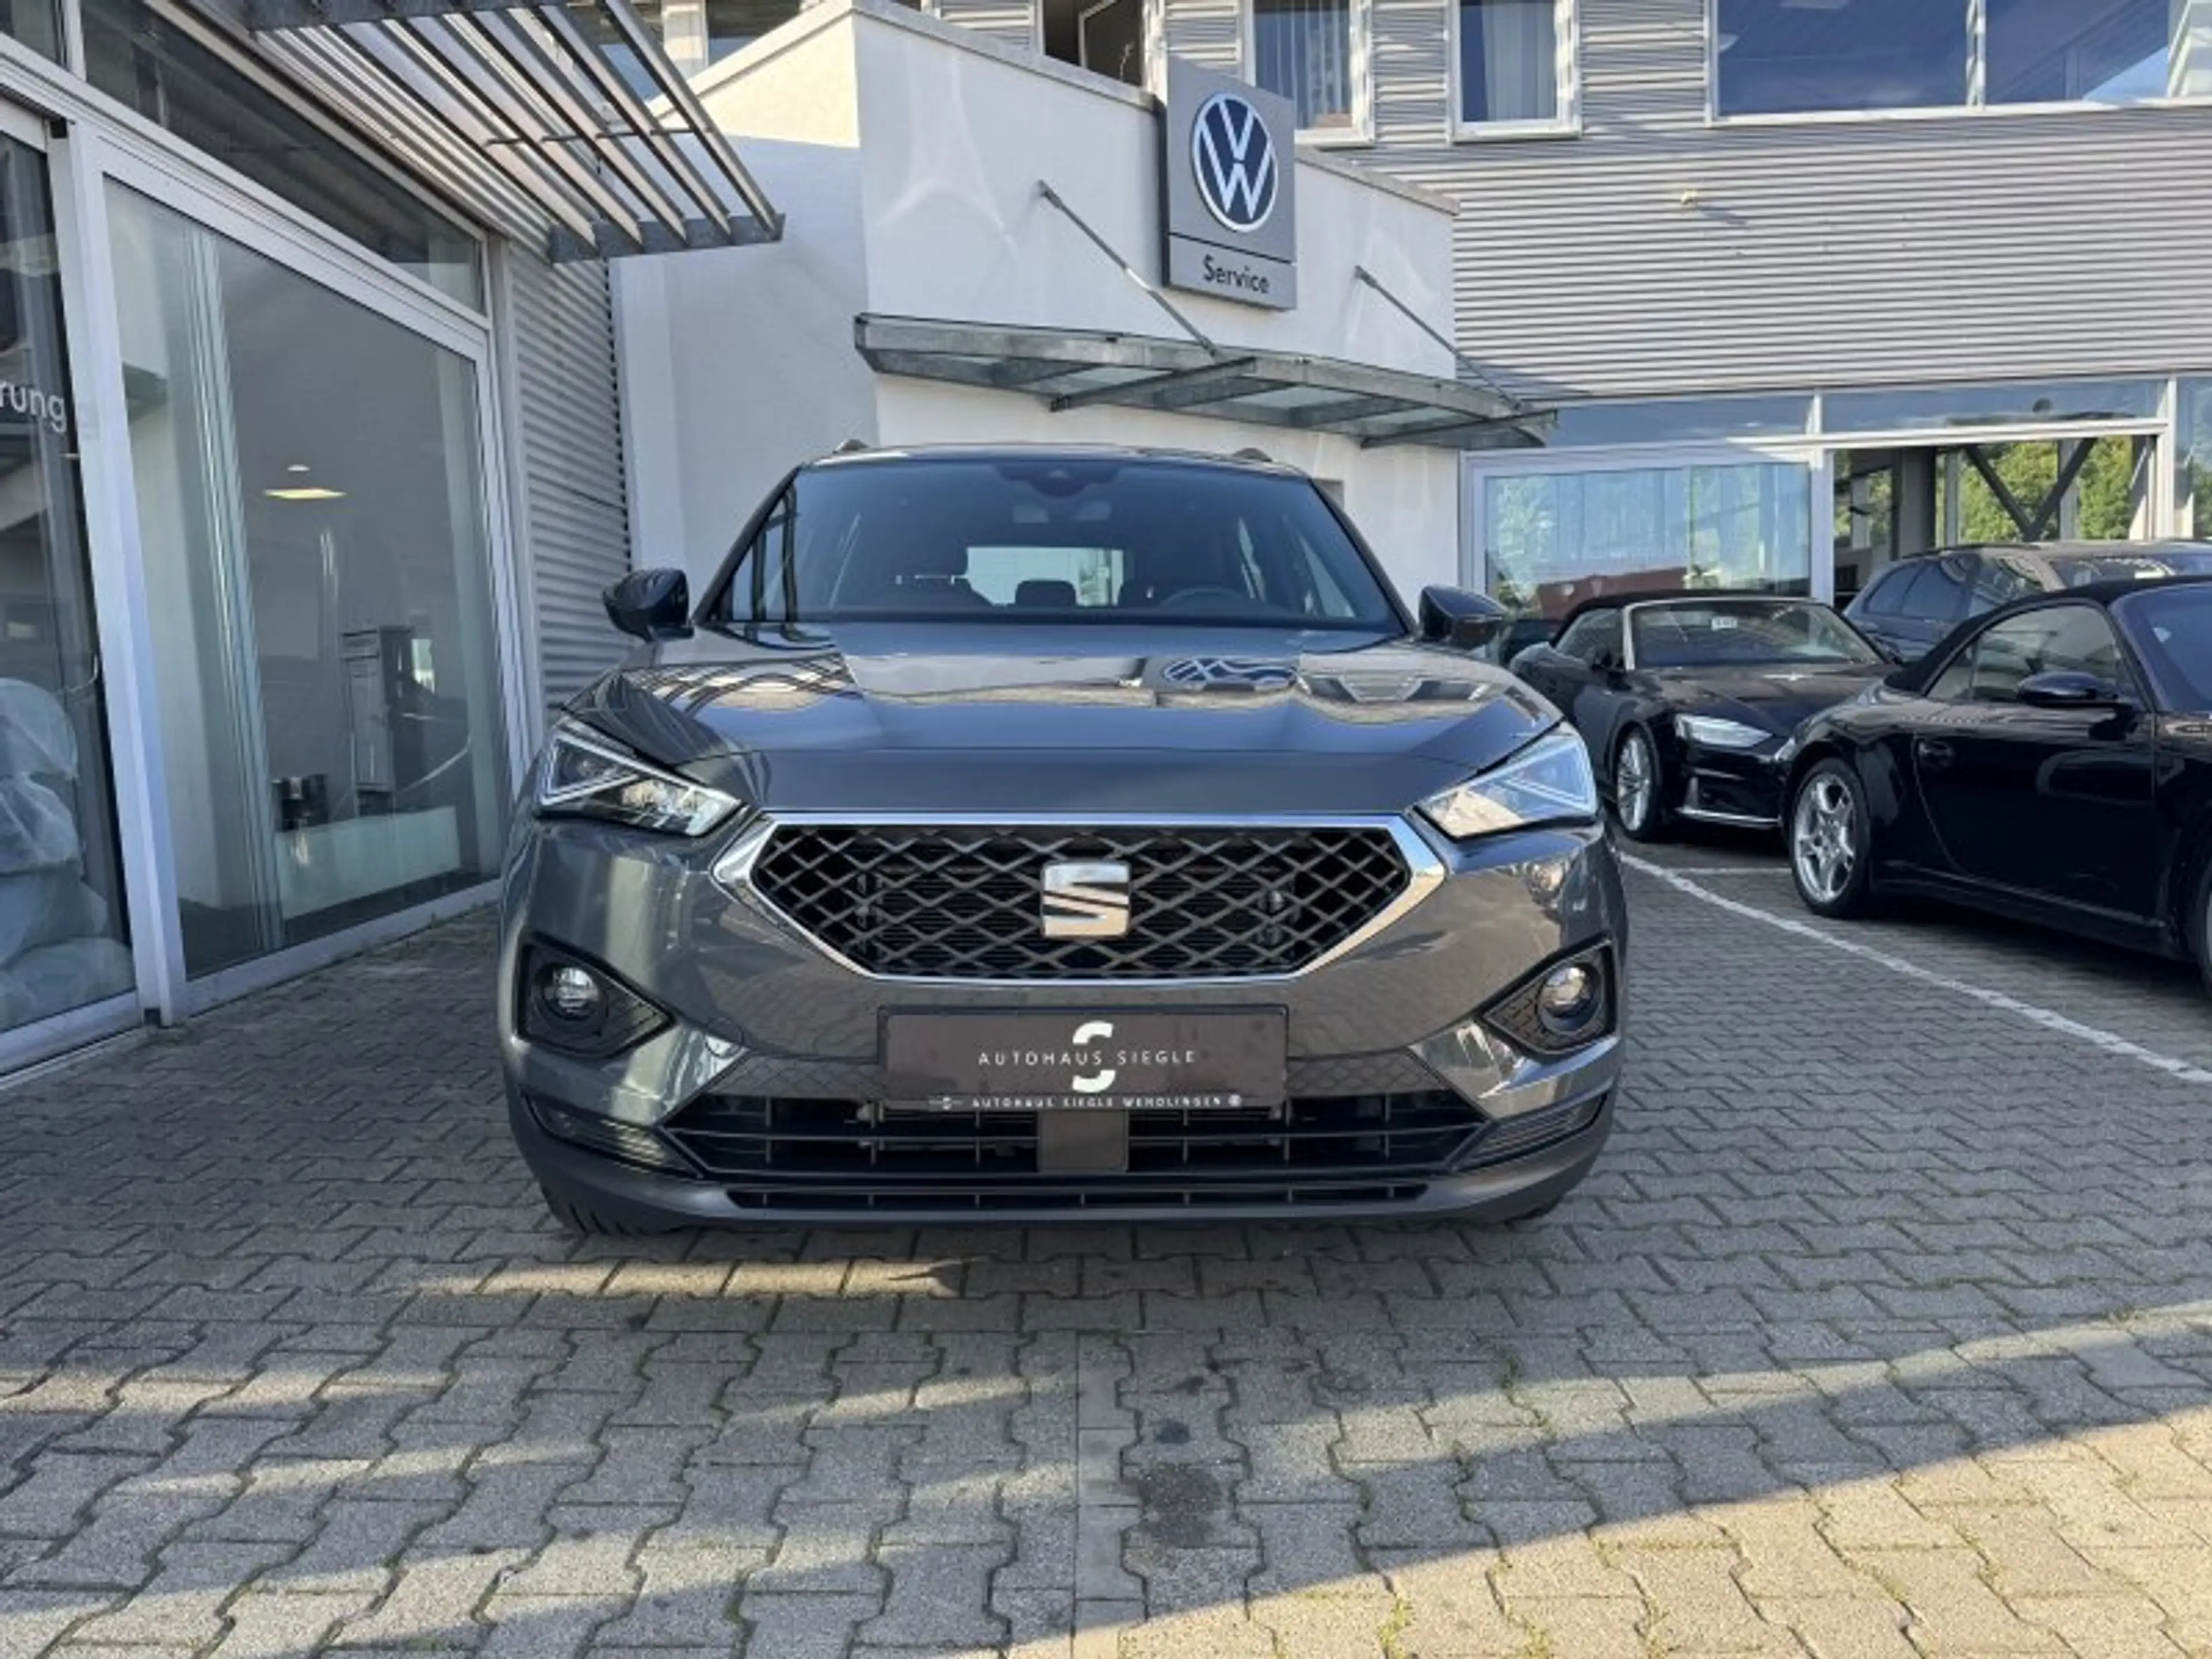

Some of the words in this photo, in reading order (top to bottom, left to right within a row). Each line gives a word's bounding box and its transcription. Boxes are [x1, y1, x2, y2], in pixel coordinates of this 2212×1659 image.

[1203, 253, 1270, 294] Service
[978, 1050, 1103, 1066] AUTOHAUS
[1116, 1049, 1195, 1066] SIEGLE
[972, 1096, 1054, 1108] AUTOHAUS
[1063, 1096, 1113, 1108] SIEGLE
